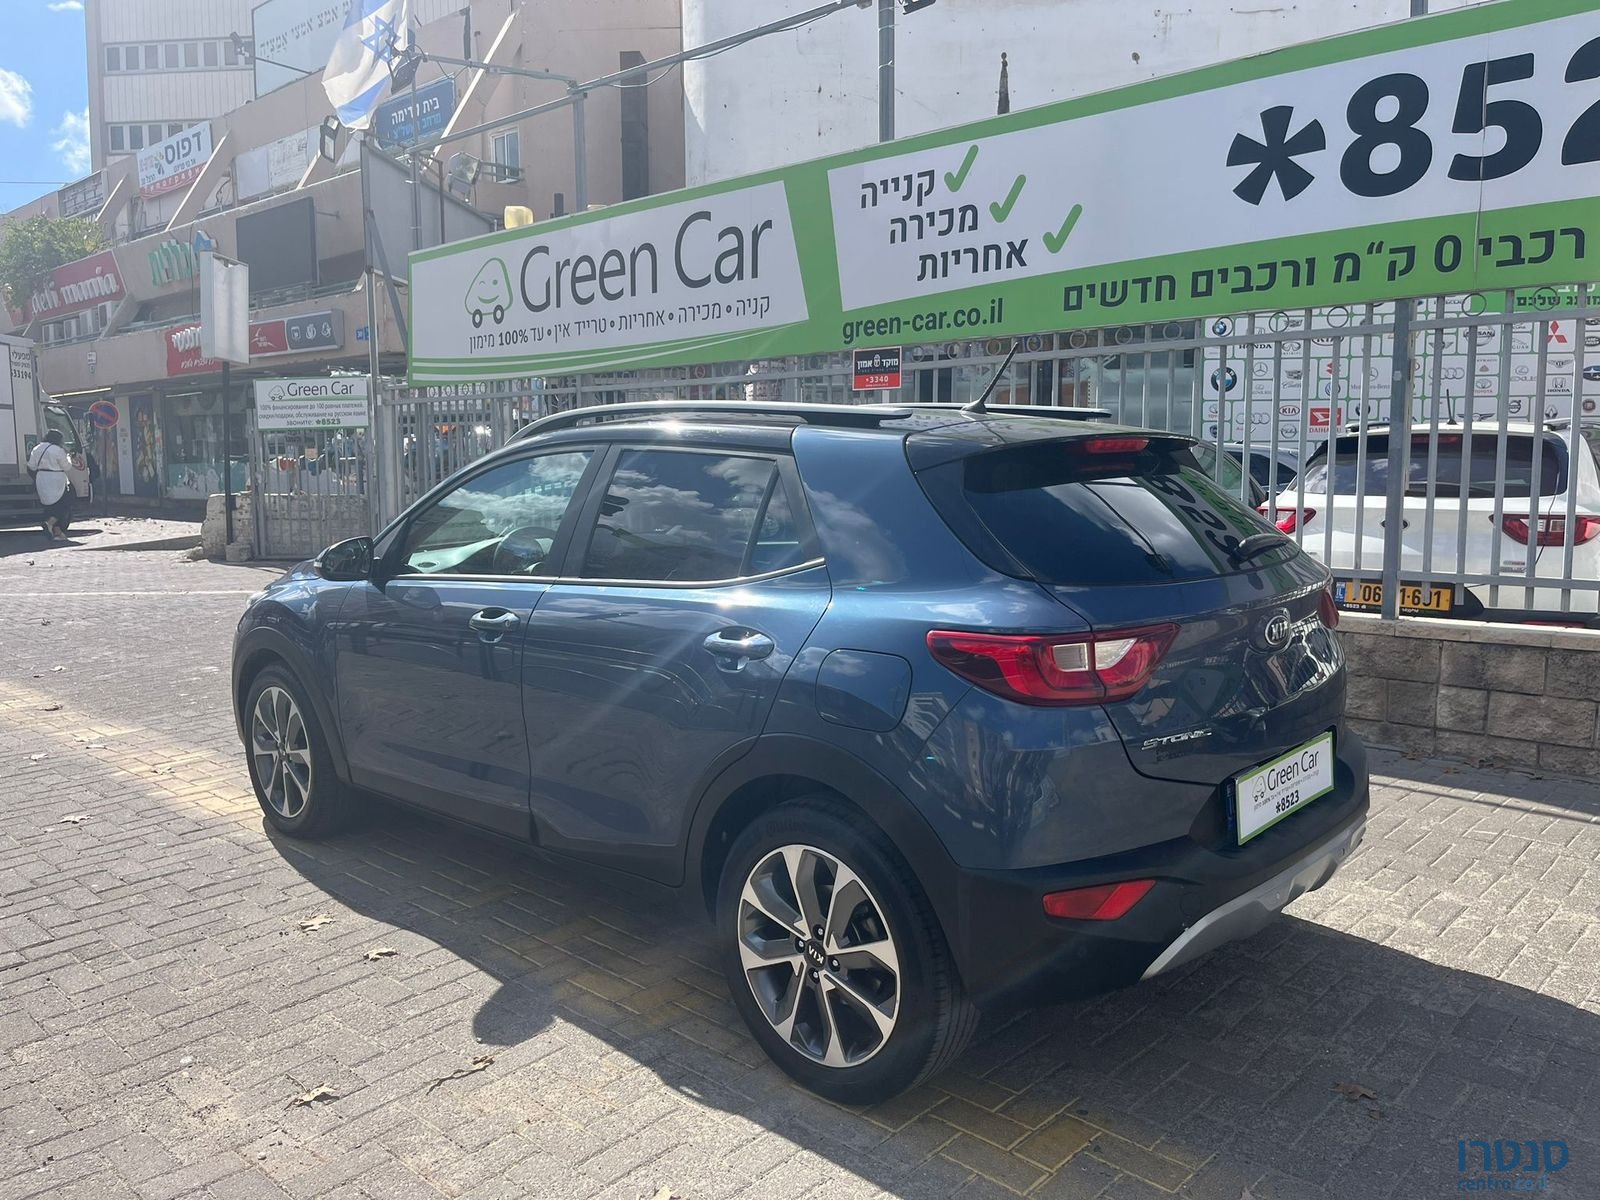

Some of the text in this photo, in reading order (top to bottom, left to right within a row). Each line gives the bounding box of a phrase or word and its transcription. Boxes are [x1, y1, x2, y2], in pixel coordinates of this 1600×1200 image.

[423, 97, 440, 114] בית
[164, 130, 202, 165] דפוס
[860, 169, 936, 208] קנייה
[889, 203, 979, 245] מכירה
[520, 210, 773, 313] Green Car
[916, 238, 1029, 282] אחריות
[1434, 234, 1462, 273] 0
[1477, 227, 1586, 269] רכבי
[1063, 274, 1176, 311] חדשים
[1190, 256, 1316, 298] ורכבים
[469, 294, 771, 354] קניה מכירה אחריות טרייד אין עד 100% מימון
[842, 297, 1004, 345] green-car.co.il
[881, 358, 899, 368] מוקד
[287, 381, 354, 397] Green Car
[1142, 728, 1212, 750] STONIC
[1267, 760, 1299, 791] Green
[1300, 750, 1319, 776] Car
[808, 945, 825, 964] KIA
